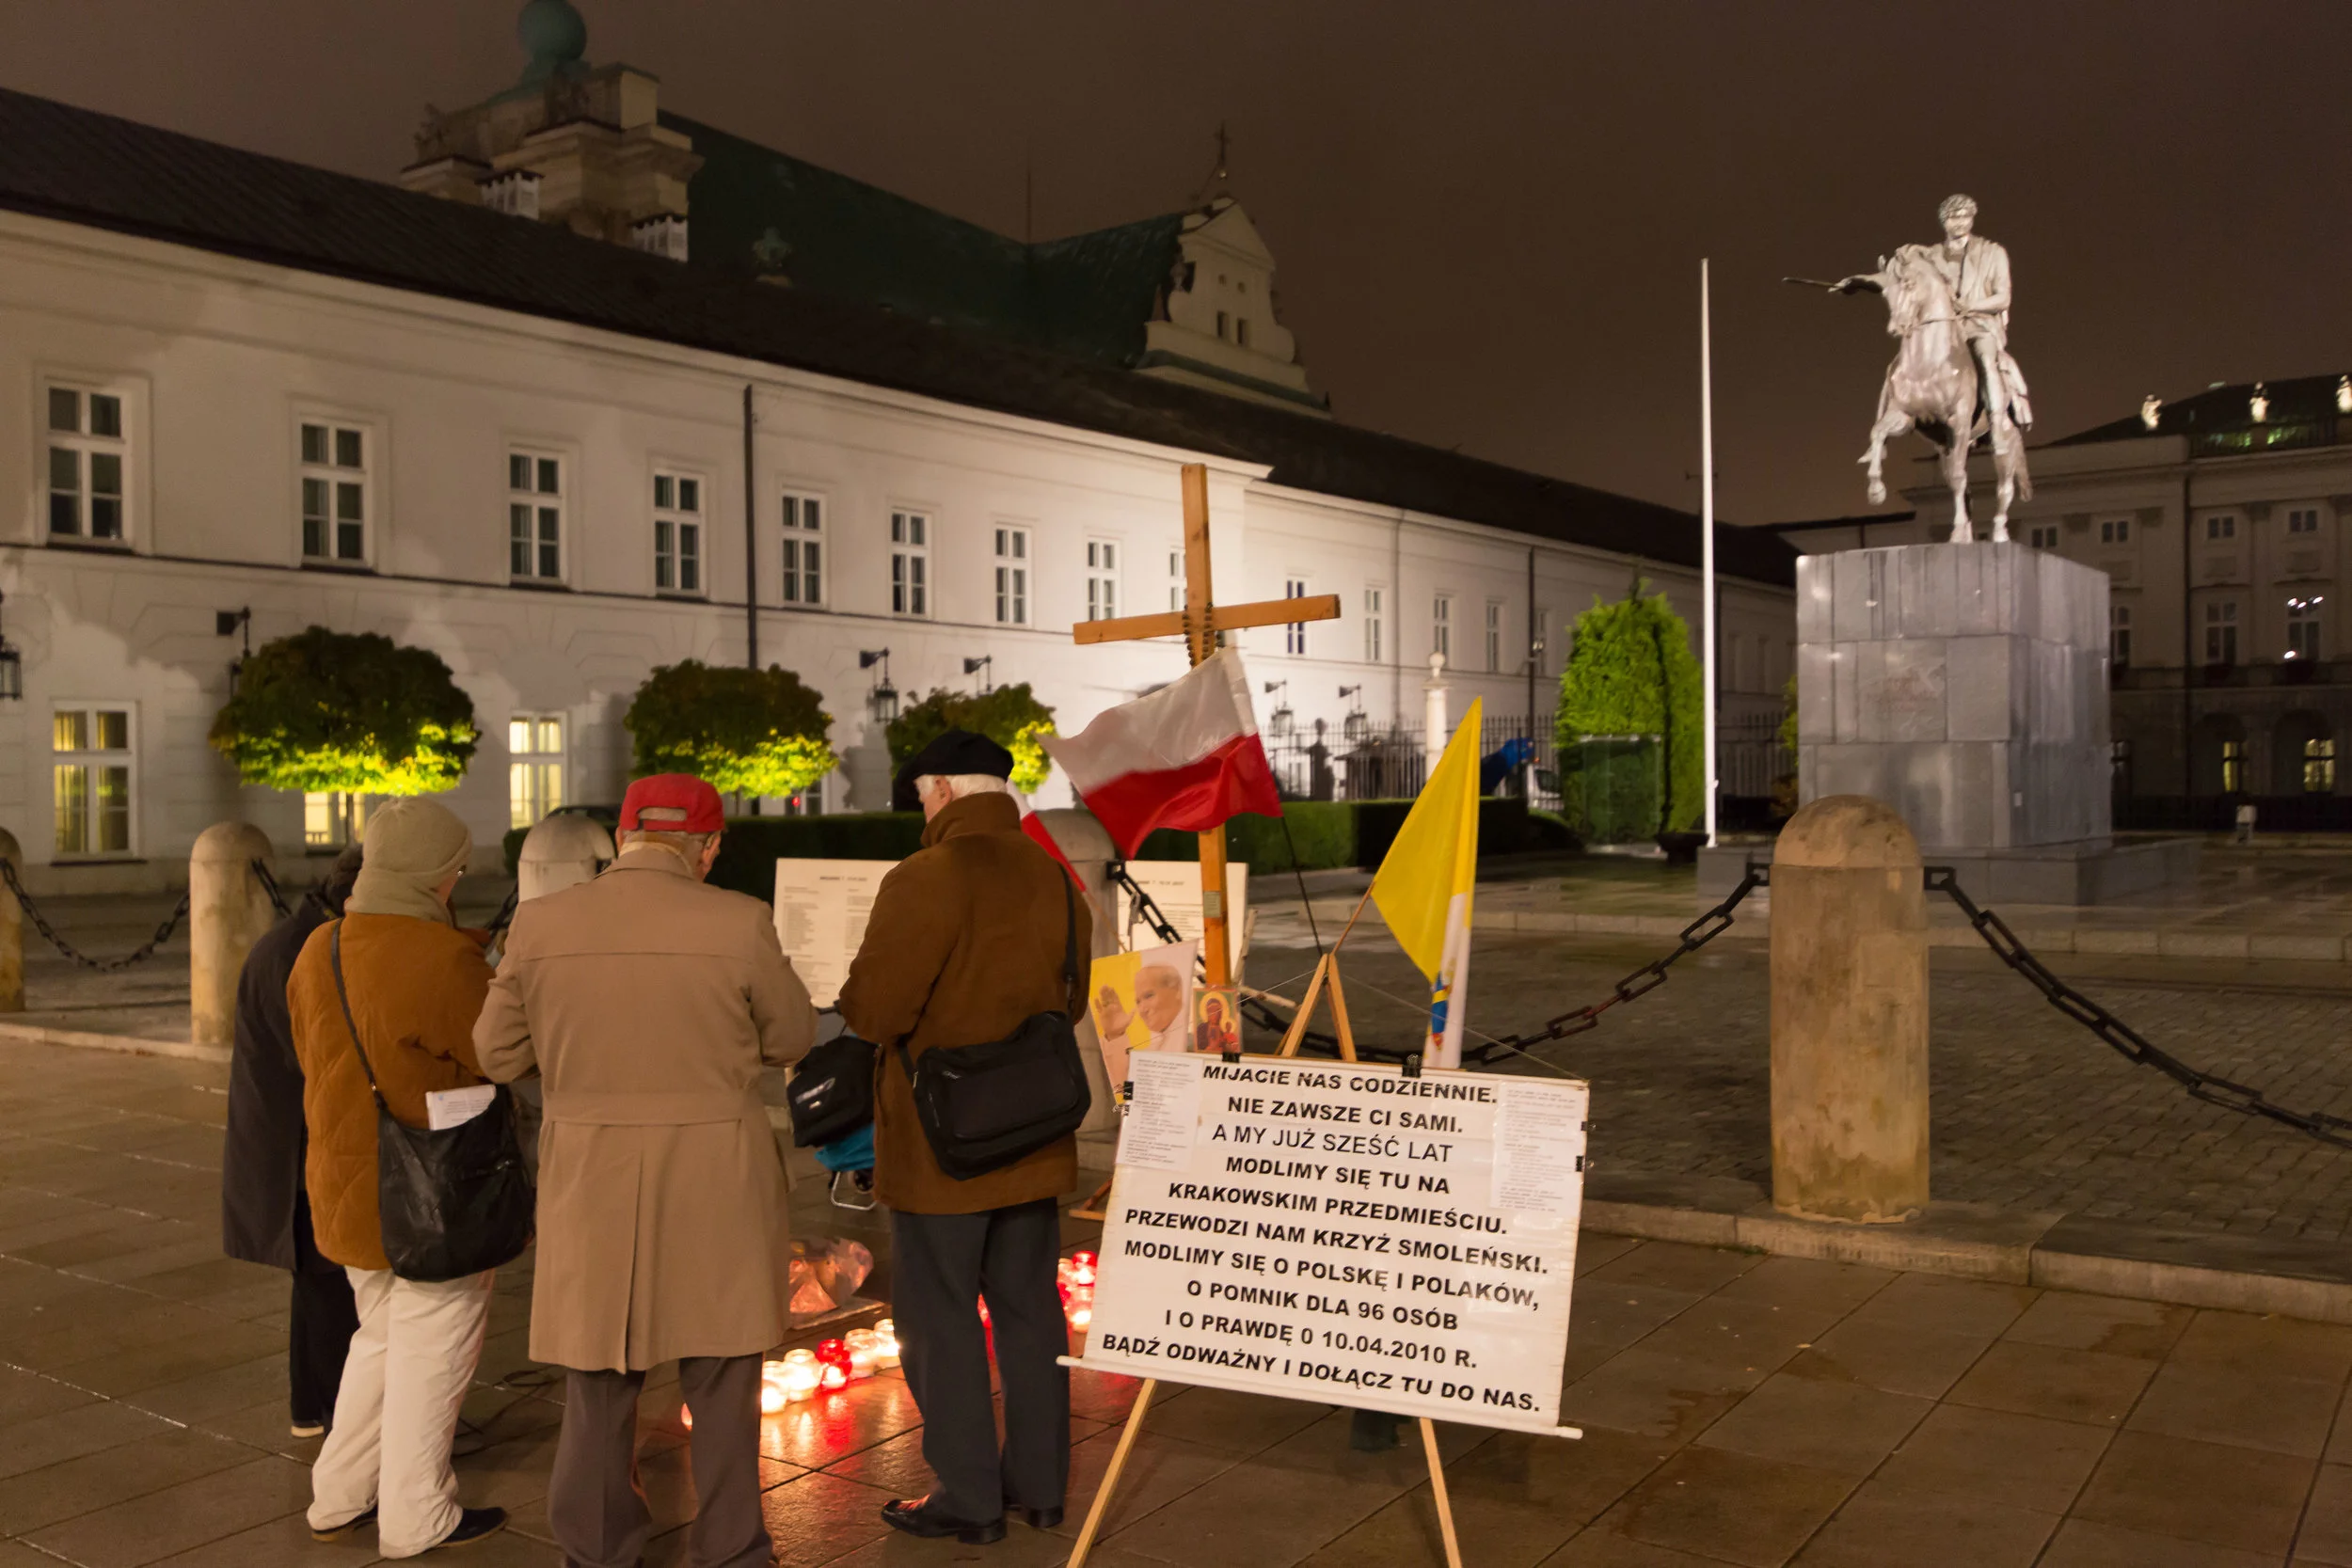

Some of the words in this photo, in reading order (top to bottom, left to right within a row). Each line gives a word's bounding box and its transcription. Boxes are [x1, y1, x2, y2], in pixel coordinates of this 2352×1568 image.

[1202, 1065, 1292, 1085] MIJACIE
[1296, 1071, 1343, 1090] NAS
[1349, 1076, 1497, 1104] CODZIENNIE.
[1228, 1096, 1264, 1115] NIE
[1269, 1100, 1362, 1124] ZAWSZE
[1369, 1109, 1391, 1127] CI
[1399, 1111, 1463, 1133] SAMI.
[1211, 1123, 1228, 1142] A
[1233, 1125, 1267, 1145] MY
[1272, 1127, 1316, 1149] JUŻ
[1322, 1132, 1400, 1158] SZEŚĆ
[1407, 1141, 1454, 1163] LAT
[1225, 1156, 1329, 1181] MODLIMY
[1335, 1166, 1372, 1191] SIĘ
[1378, 1170, 1410, 1190] TU
[1418, 1175, 1450, 1195] NA
[1168, 1182, 1318, 1212] KRAKOWSKIM
[1324, 1197, 1507, 1237] PRZEDMIEŚCIU.
[1124, 1208, 1249, 1237] PRZEWODZI
[1255, 1222, 1306, 1243] NAM
[1312, 1228, 1391, 1254] KRZYŻ
[1397, 1239, 1548, 1275] SMOLEŃSKI.
[1124, 1239, 1225, 1266] MODLIMY
[1231, 1252, 1266, 1276] SIĘ
[1273, 1257, 1289, 1275] O
[1296, 1259, 1389, 1292] POLSKĘ
[1396, 1272, 1404, 1290] I
[1186, 1279, 1202, 1297] O
[1209, 1282, 1299, 1309] POMNIK
[1306, 1294, 1350, 1317] DLA
[1358, 1301, 1385, 1321] 96
[1392, 1306, 1458, 1331] OSÓB
[1165, 1309, 1171, 1325] I
[1179, 1311, 1194, 1328] O
[1200, 1314, 1294, 1347] PRAWDĘ
[1322, 1330, 1447, 1364] 10.04.2010
[1454, 1349, 1477, 1369] R.
[1102, 1333, 1161, 1357] BĄDŹ
[1166, 1342, 1278, 1373] ODWAŻNY
[1283, 1358, 1292, 1376] I
[1297, 1361, 1394, 1390] DOŁĄCZ
[1401, 1375, 1434, 1396] TU
[1440, 1381, 1475, 1402] DO
[1483, 1387, 1540, 1412] NAS.
